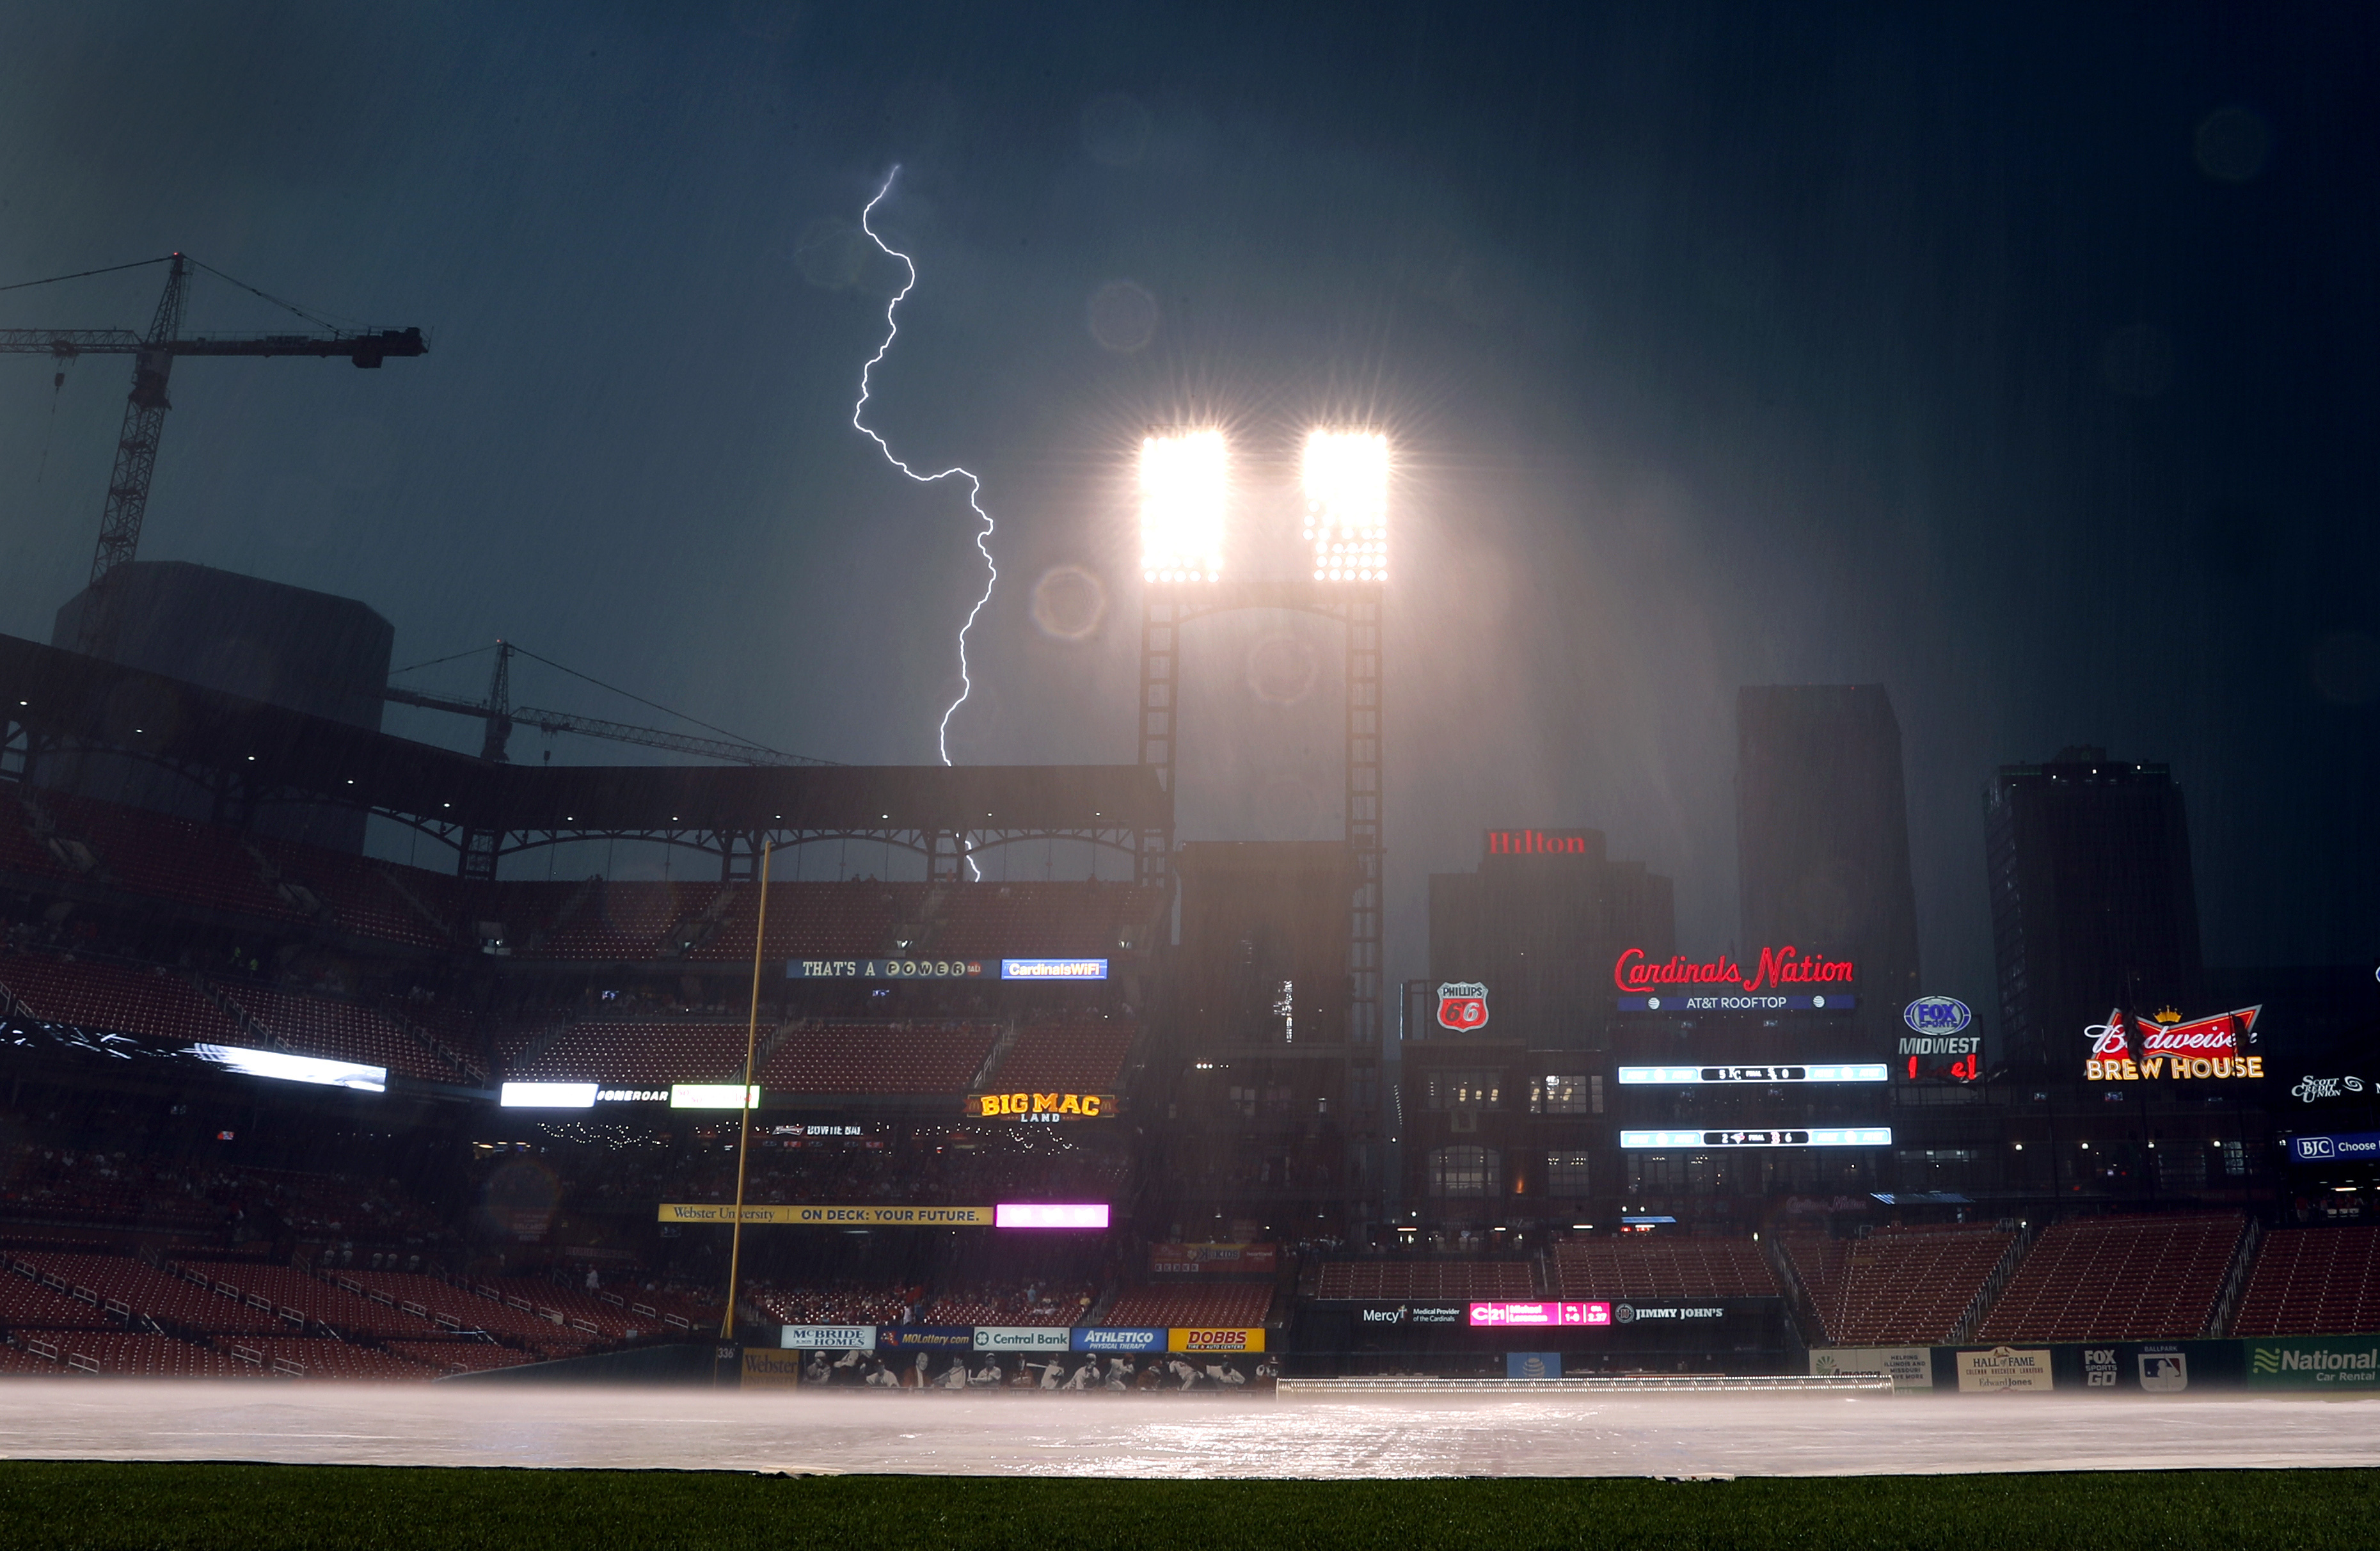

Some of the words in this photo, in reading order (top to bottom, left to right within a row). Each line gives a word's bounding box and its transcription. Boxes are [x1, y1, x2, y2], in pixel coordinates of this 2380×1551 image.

[1489, 829, 1585, 854] Hilton
[802, 961, 856, 976] THAT'S
[864, 961, 876, 976] A
[1008, 963, 1100, 976] CardinalsWiFi
[1614, 948, 1741, 992] Cardinals
[1742, 945, 1854, 992] Nation
[1443, 986, 1482, 998] PHILLIPS
[1686, 997, 1719, 1010] AT&T
[1720, 996, 1787, 1009] ROOFTOP
[1445, 1001, 1480, 1022] 66
[1918, 1004, 1956, 1021] FOX
[1898, 1037, 1981, 1054] MIDWEST
[1719, 1070, 1726, 1079] 5
[1729, 1067, 1741, 1081] KC
[1782, 1070, 1789, 1079] 0
[2086, 1057, 2163, 1081] BREW
[2170, 1056, 2264, 1079] HOUSE
[2302, 1075, 2340, 1086] SCOTT
[2290, 1084, 2336, 1097] CREDIT
[2302, 1089, 2342, 1103] UNION
[980, 1093, 1029, 1117] BIG
[1032, 1093, 1101, 1117] MAC
[1020, 1113, 1061, 1122] LAND
[1722, 1134, 1728, 1143] 2
[1785, 1133, 1791, 1143] 6
[2302, 1140, 2330, 1156] BJC
[2338, 1141, 2376, 1152] Choose
[674, 1207, 716, 1219] Webster
[719, 1207, 775, 1223] Unversity
[801, 1209, 822, 1221] ON
[826, 1209, 871, 1221] DECK:
[874, 1210, 915, 1221] YOUR
[919, 1211, 979, 1222] FUTURE.
[1363, 1309, 1399, 1324] Mercy
[1491, 1308, 1505, 1320] 21
[1635, 1308, 1678, 1320] JIMMY
[1680, 1308, 1723, 1319] JOHN'S
[901, 1333, 969, 1346] MOLottery.com
[994, 1333, 1035, 1345] Central
[1038, 1333, 1068, 1344] Bank
[1084, 1330, 1154, 1343] ATHLETICO
[1188, 1331, 1247, 1344] DOBBS
[745, 1355, 798, 1373] Webster
[1973, 1358, 1999, 1367] HALL
[2000, 1358, 2008, 1367] of
[2008, 1356, 2035, 1367] FAME
[2084, 1349, 2116, 1365] FOX
[2088, 1371, 2116, 1386] GO
[2316, 1372, 2336, 1381] Car
[2339, 1371, 2376, 1381] Rental
